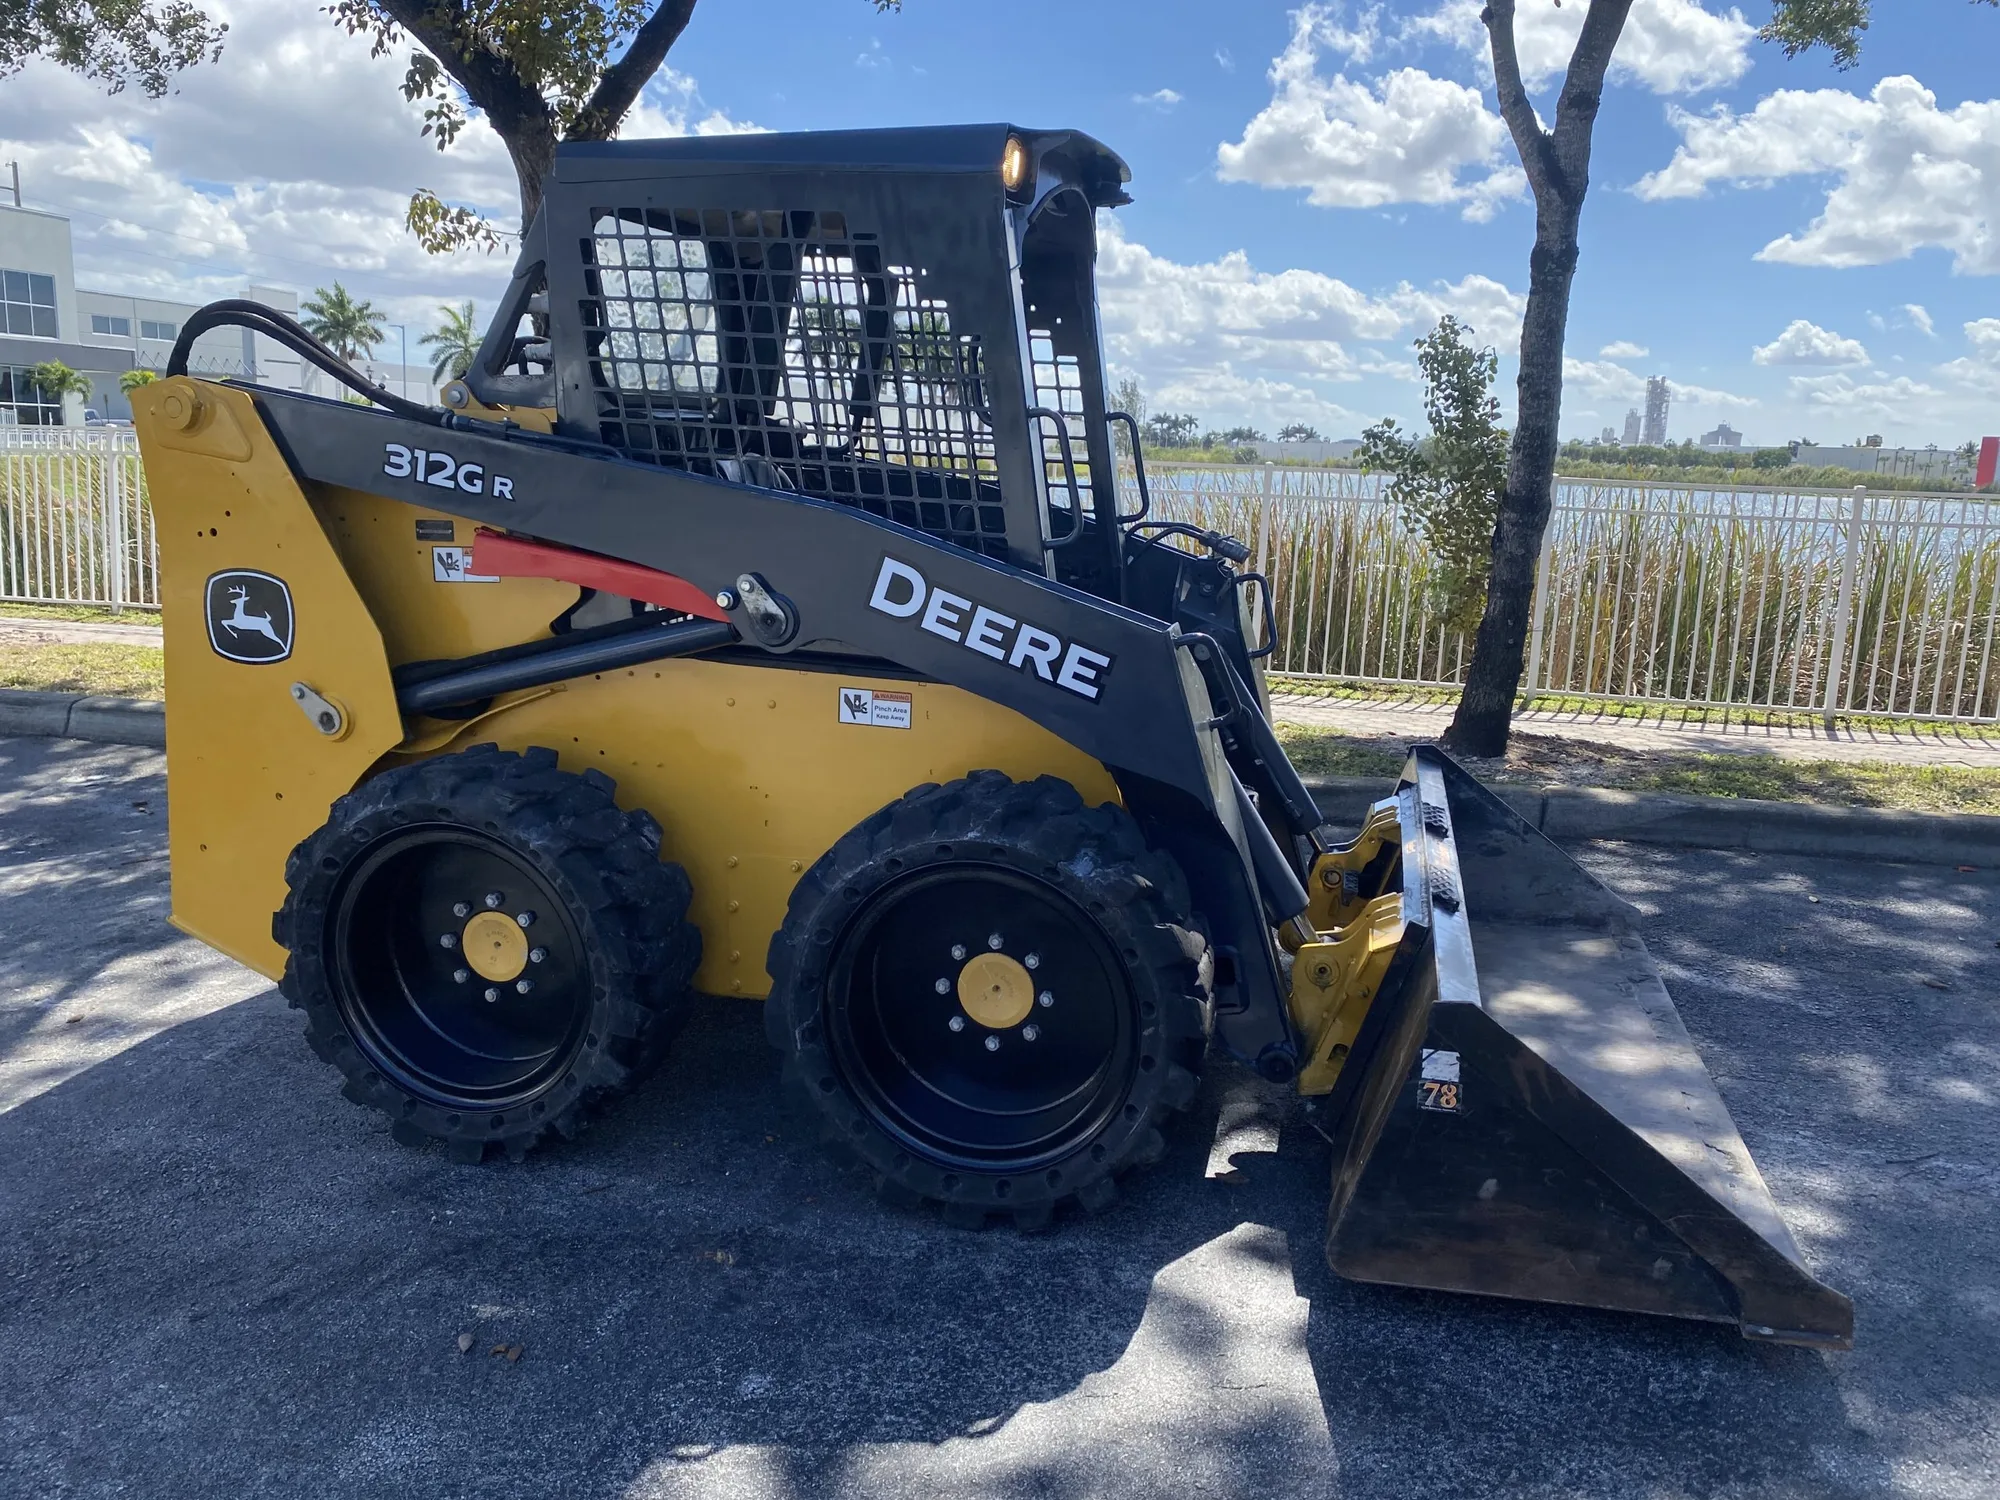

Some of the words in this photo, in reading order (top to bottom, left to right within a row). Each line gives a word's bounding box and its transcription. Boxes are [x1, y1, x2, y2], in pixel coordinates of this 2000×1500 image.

[384, 443, 484, 494] 312G
[492, 475, 514, 500] R
[869, 556, 1111, 699] DEERE
[1423, 1083, 1457, 1108] 78
